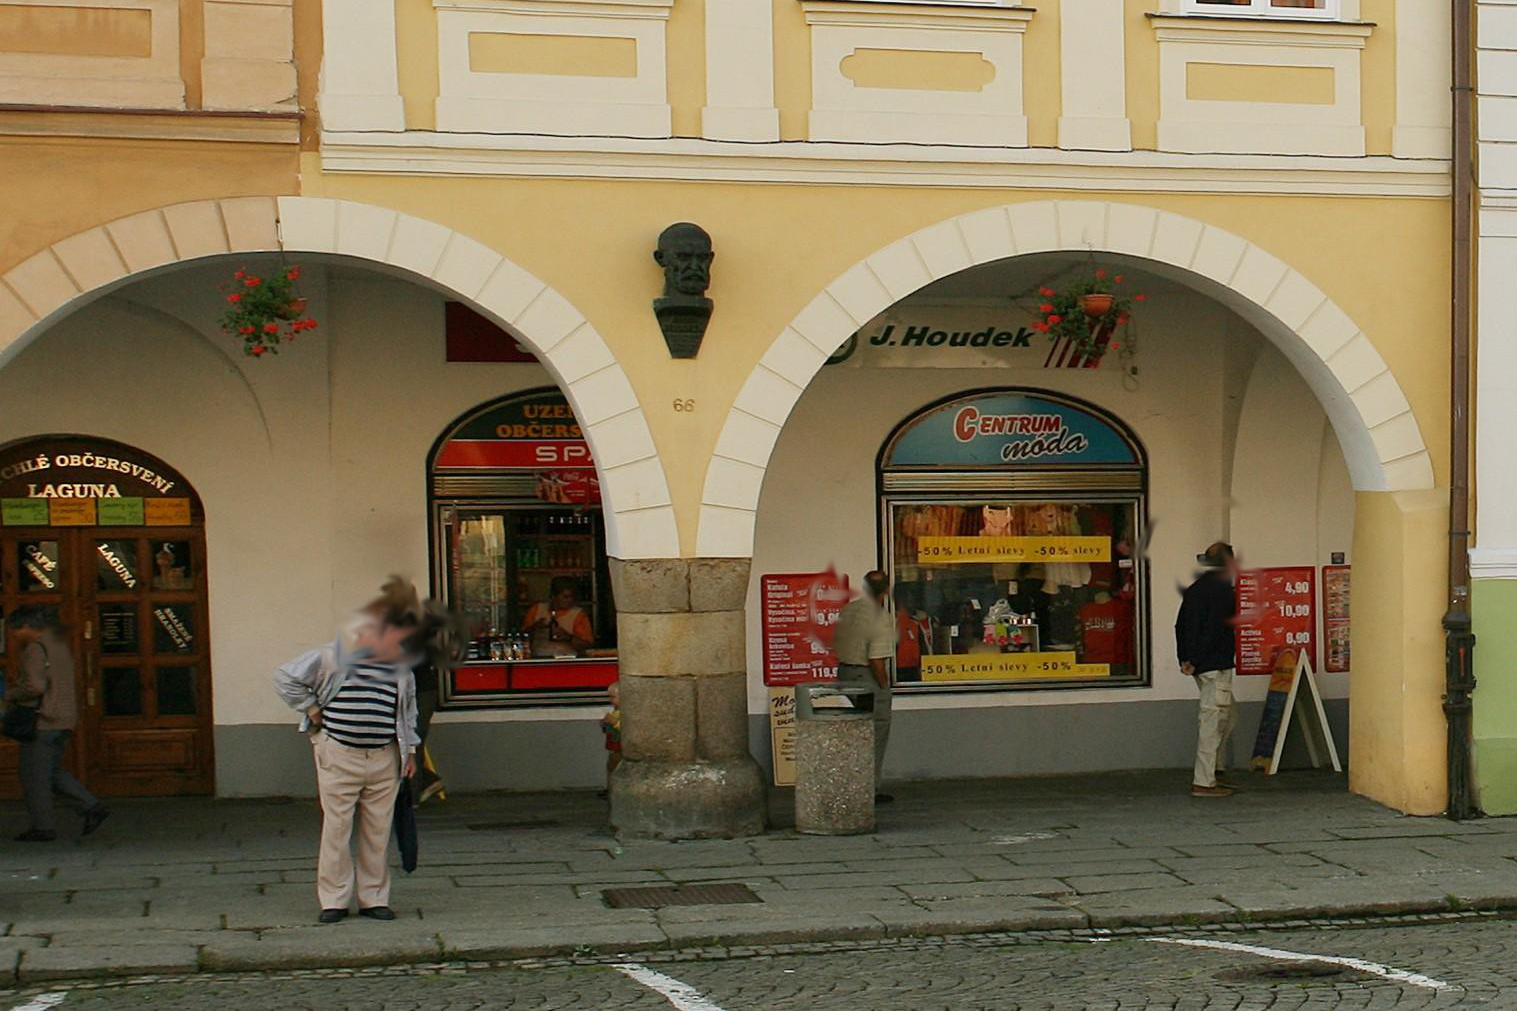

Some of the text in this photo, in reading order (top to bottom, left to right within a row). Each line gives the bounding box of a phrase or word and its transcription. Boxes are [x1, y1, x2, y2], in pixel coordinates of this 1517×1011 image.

[673, 398, 696, 413] 66
[954, 406, 1063, 441] CENTRUM
[1001, 427, 1089, 461] móda
[55, 452, 175, 494] OBČERSVENÍ
[28, 484, 122, 499] LAGUNA
[97, 543, 137, 588] LAGUNA
